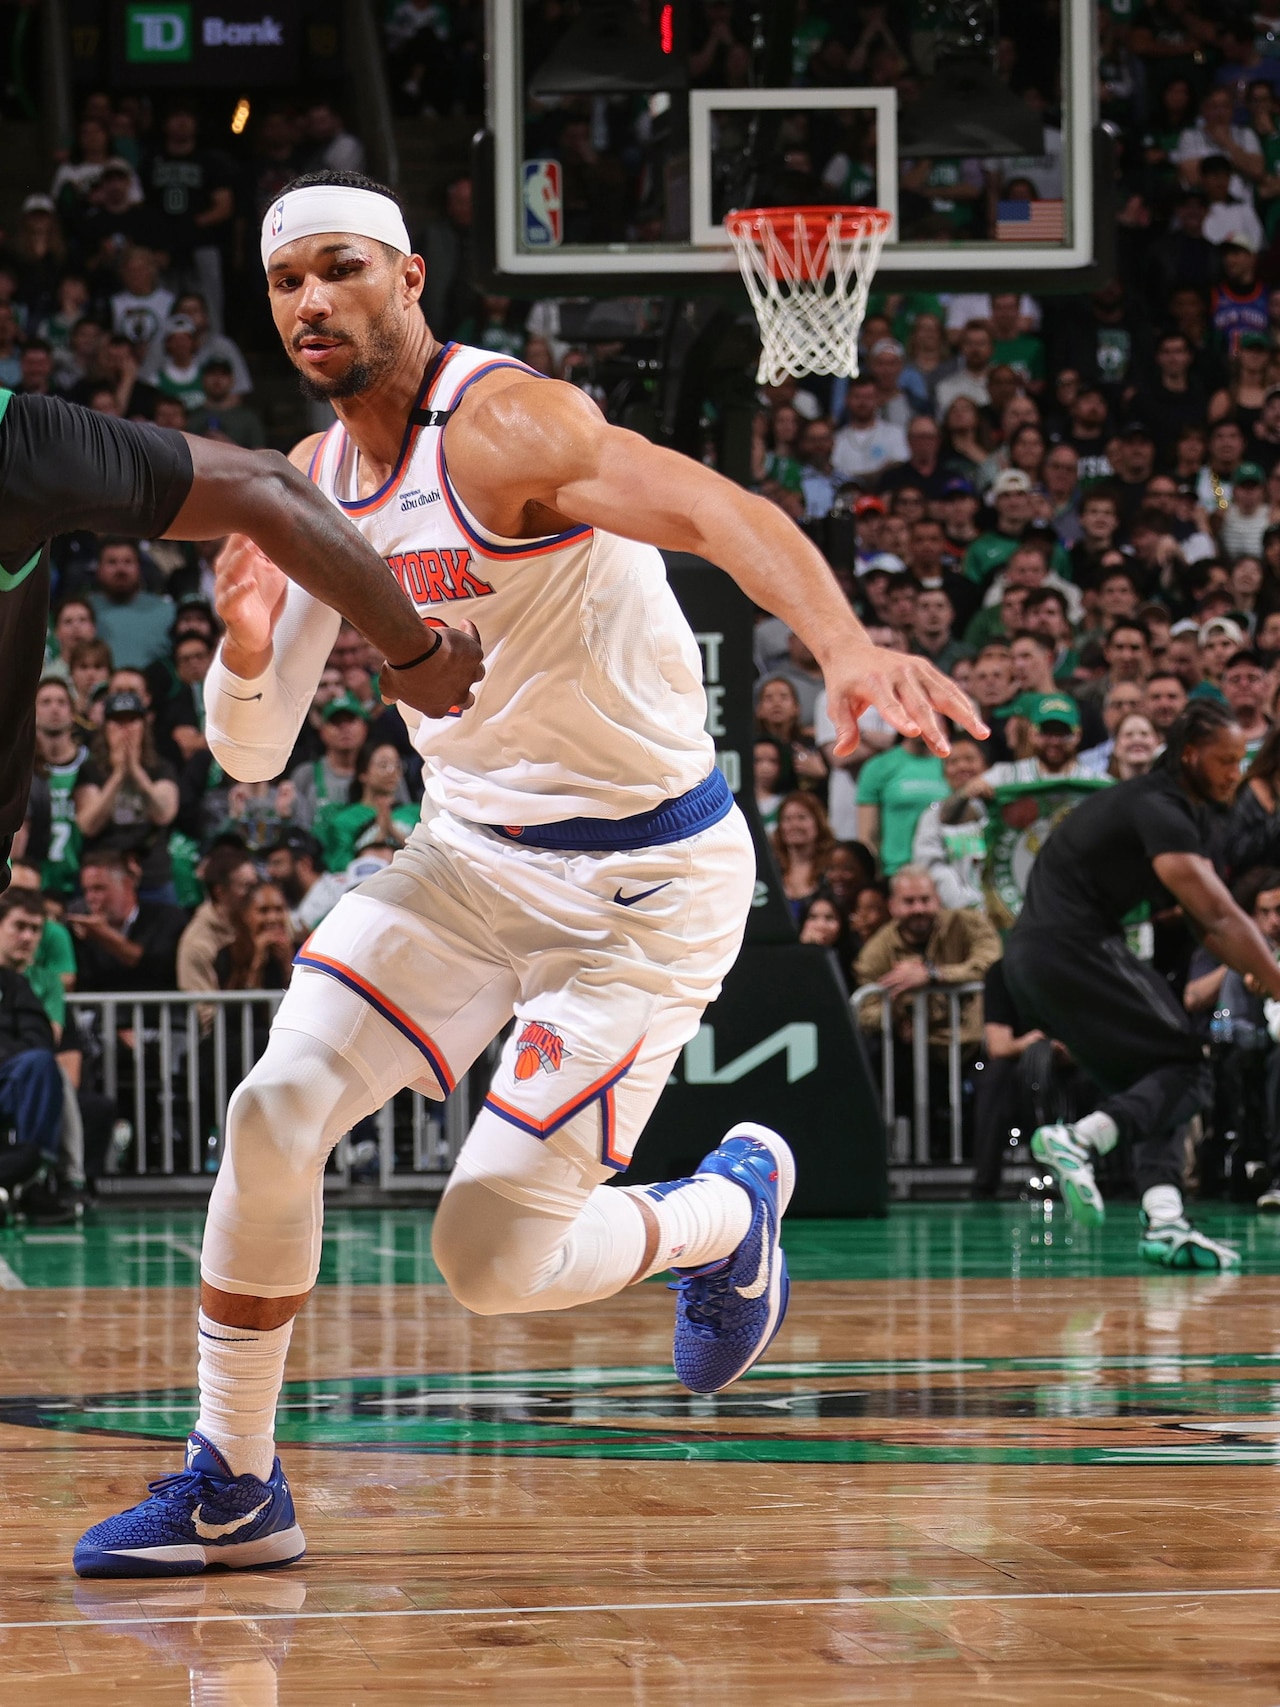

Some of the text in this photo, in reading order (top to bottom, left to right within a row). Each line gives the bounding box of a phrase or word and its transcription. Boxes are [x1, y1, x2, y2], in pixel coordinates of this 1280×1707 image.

[130, 13, 283, 51] TD Bank
[401, 488, 441, 511] abu dhabi
[384, 547, 497, 606] YORK
[48, 821, 72, 863] 7
